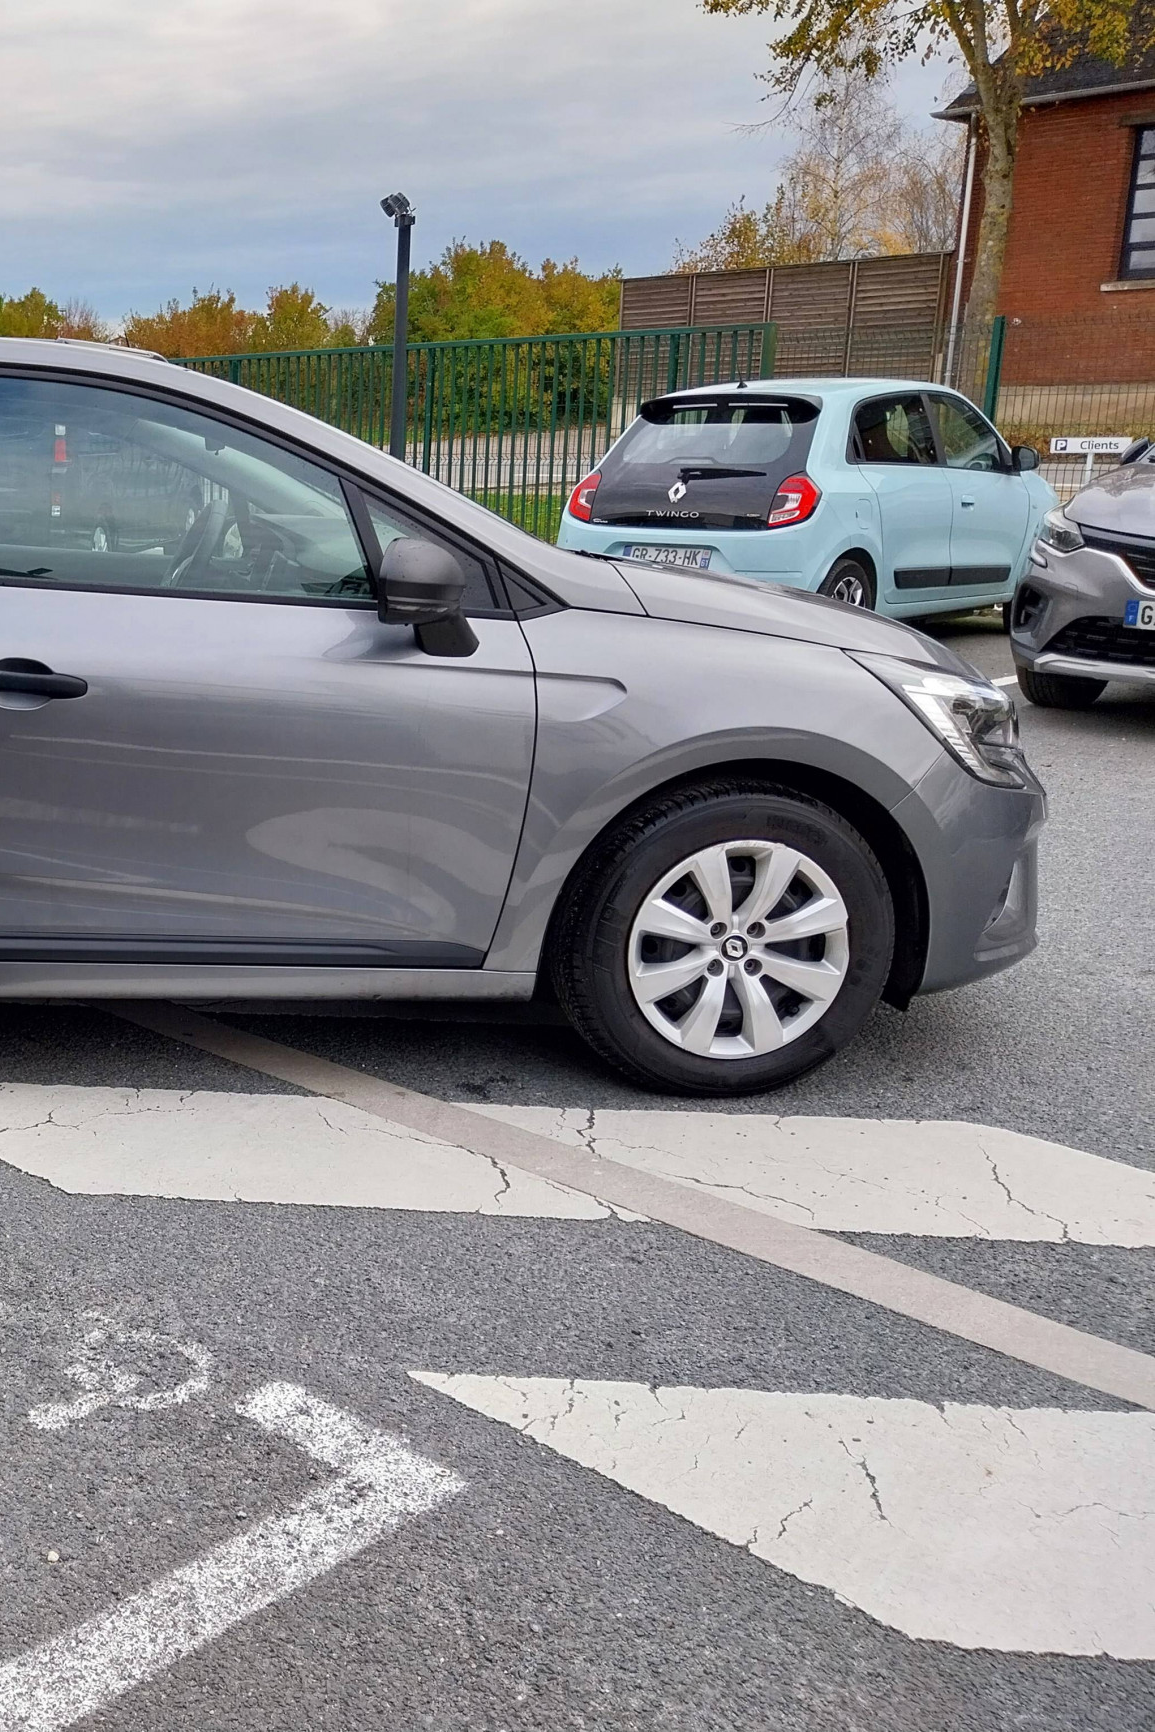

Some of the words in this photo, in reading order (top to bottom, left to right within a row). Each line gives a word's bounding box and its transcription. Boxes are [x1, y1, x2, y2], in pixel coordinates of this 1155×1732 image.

[1080, 440, 1119, 450] Clients
[646, 510, 700, 519] TWINGO
[632, 547, 701, 566] GR-733-HK
[1141, 605, 1155, 625] G
